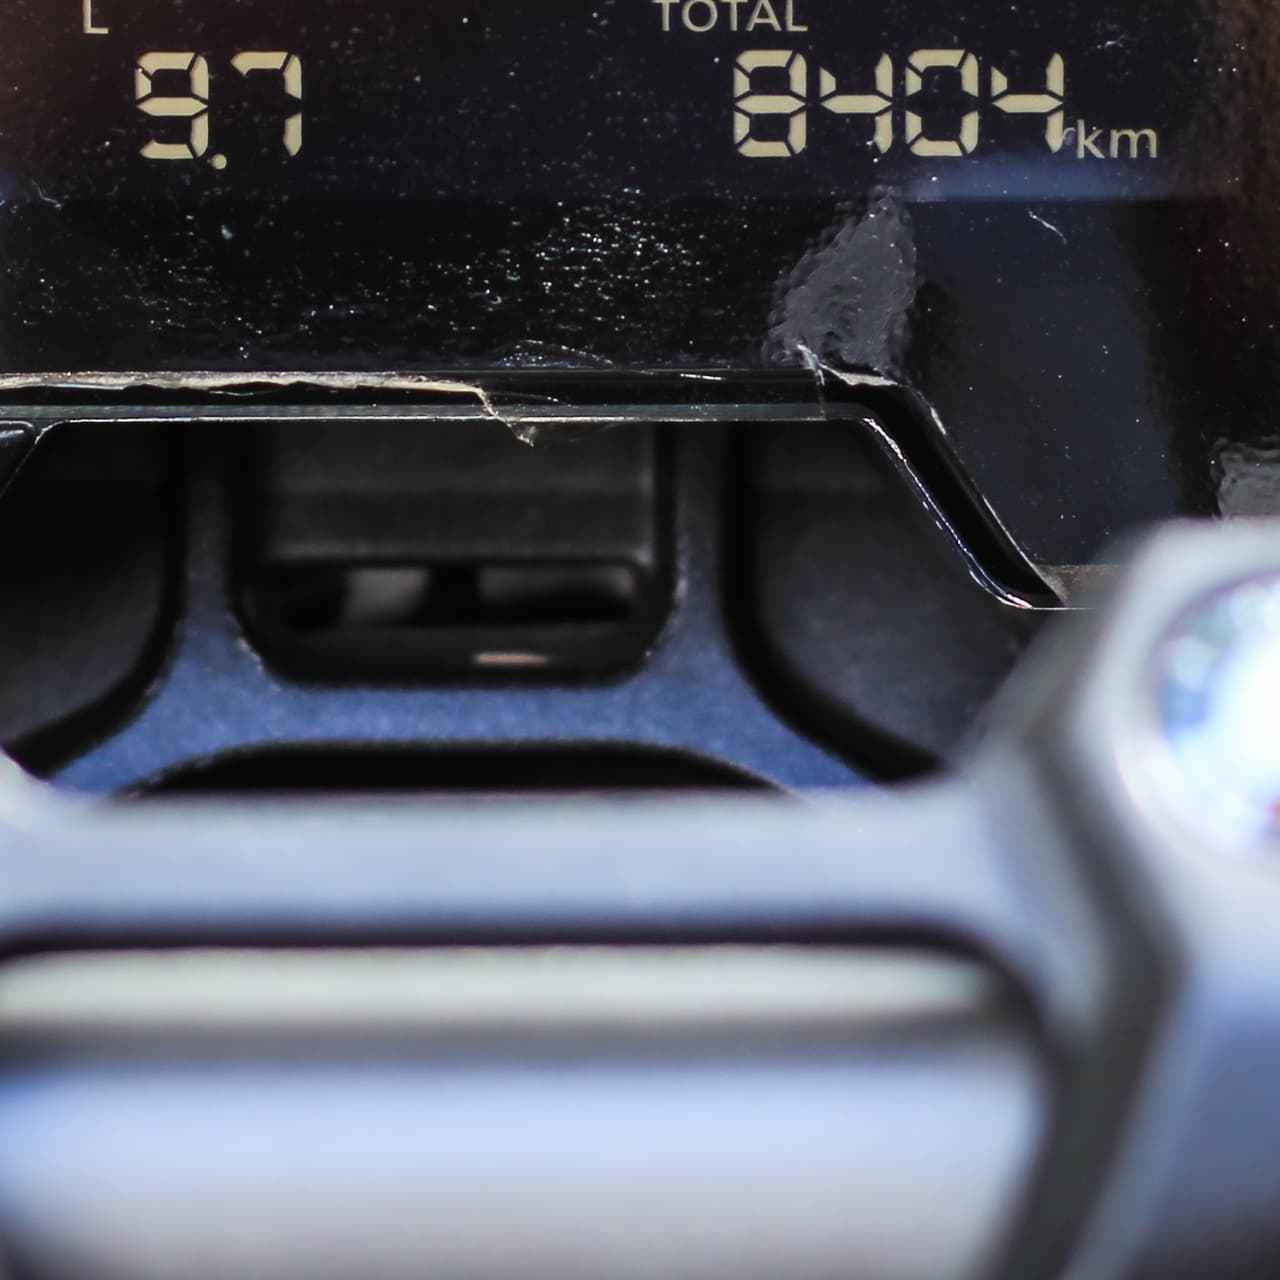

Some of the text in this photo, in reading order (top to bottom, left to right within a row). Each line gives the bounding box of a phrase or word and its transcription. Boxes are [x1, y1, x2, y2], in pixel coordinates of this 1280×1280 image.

[135, 51, 302, 170] 9.7
[733, 49, 1159, 160] 8404 km
